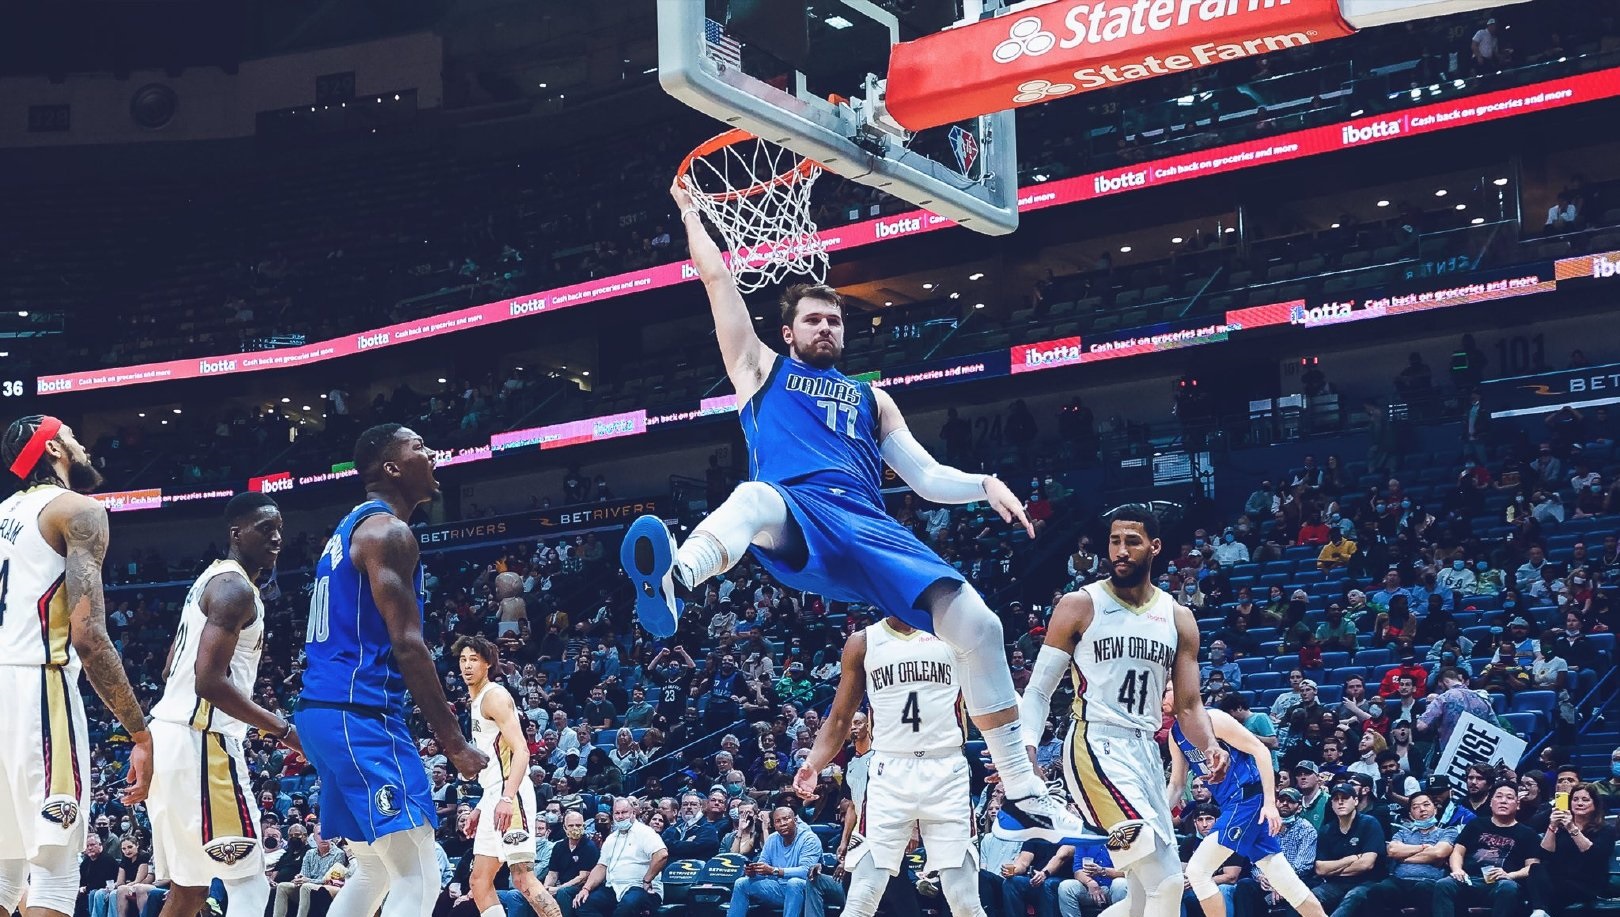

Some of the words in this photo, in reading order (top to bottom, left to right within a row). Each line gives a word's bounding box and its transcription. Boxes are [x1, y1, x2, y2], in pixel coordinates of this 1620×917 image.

[1410, 114, 1435, 127] Cash
[1436, 110, 1461, 123] back
[1461, 107, 1475, 118] on
[1476, 99, 1522, 116] groceries
[1523, 92, 1544, 106] and
[1544, 88, 1572, 101] more
[1342, 120, 1400, 144] ibotta
[1154, 165, 1177, 179] Cash
[1178, 162, 1200, 175] back
[1200, 159, 1212, 168] on
[1213, 151, 1255, 168] groceries
[1255, 146, 1273, 158] and
[1273, 142, 1298, 154] more
[1094, 172, 1146, 193] ibotta
[1034, 192, 1056, 202] more
[875, 217, 921, 239] ibotta
[552, 294, 567, 304] Cash
[567, 291, 583, 301] back
[583, 290, 592, 298] on
[592, 284, 621, 298] groceries
[621, 280, 634, 289] and
[634, 277, 651, 287] more
[1364, 297, 1390, 310] Cash
[1391, 292, 1417, 306] back
[1418, 291, 1434, 302] on
[1434, 283, 1485, 302] groceries
[1486, 279, 1508, 292] and
[1508, 275, 1539, 288] more
[510, 298, 546, 316] ibotta
[1290, 301, 1352, 325] ibotta
[394, 329, 409, 339] Cash
[408, 326, 423, 336] back
[422, 325, 430, 333] on
[430, 320, 456, 332] groceries
[456, 317, 468, 326] and
[467, 314, 482, 323] more
[357, 332, 390, 349] ibotta
[1090, 342, 1113, 354] Cash
[1113, 338, 1137, 350] back
[1137, 337, 1151, 346] on
[1151, 328, 1196, 346] groceries
[1196, 325, 1215, 337] and
[200, 359, 237, 374] ibotta
[243, 356, 258, 367] Cash
[258, 355, 274, 366] back
[274, 355, 283, 364] on
[283, 352, 310, 365] groceries
[320, 347, 335, 356] more
[1025, 345, 1081, 367] ibotta
[78, 376, 93, 386] Cash
[116, 371, 143, 384] groceries
[155, 368, 171, 377] more
[892, 376, 903, 385] on
[904, 370, 944, 385] groceries
[944, 365, 962, 378] and
[961, 363, 985, 375] more
[3, 380, 24, 397] 36
[37, 378, 74, 393] ibotta
[785, 373, 862, 406] DALLAS
[643, 416, 659, 426] Cash
[660, 413, 678, 424] back
[678, 411, 688, 420] on
[816, 399, 858, 440] 77
[261, 477, 293, 494] ibotta
[299, 475, 313, 485] Cash
[162, 494, 172, 502] on
[172, 491, 202, 502] groceries
[203, 490, 215, 499] and
[215, 489, 233, 498] more
[560, 502, 656, 524] BETRIVERS
[421, 523, 507, 544] BETRIVERS
[1093, 636, 1125, 664] NEW
[870, 663, 895, 693] NEW
[897, 660, 953, 686] ORLEANS
[664, 689, 676, 702] 23
[1117, 668, 1150, 716] 41
[900, 690, 923, 733] 4
